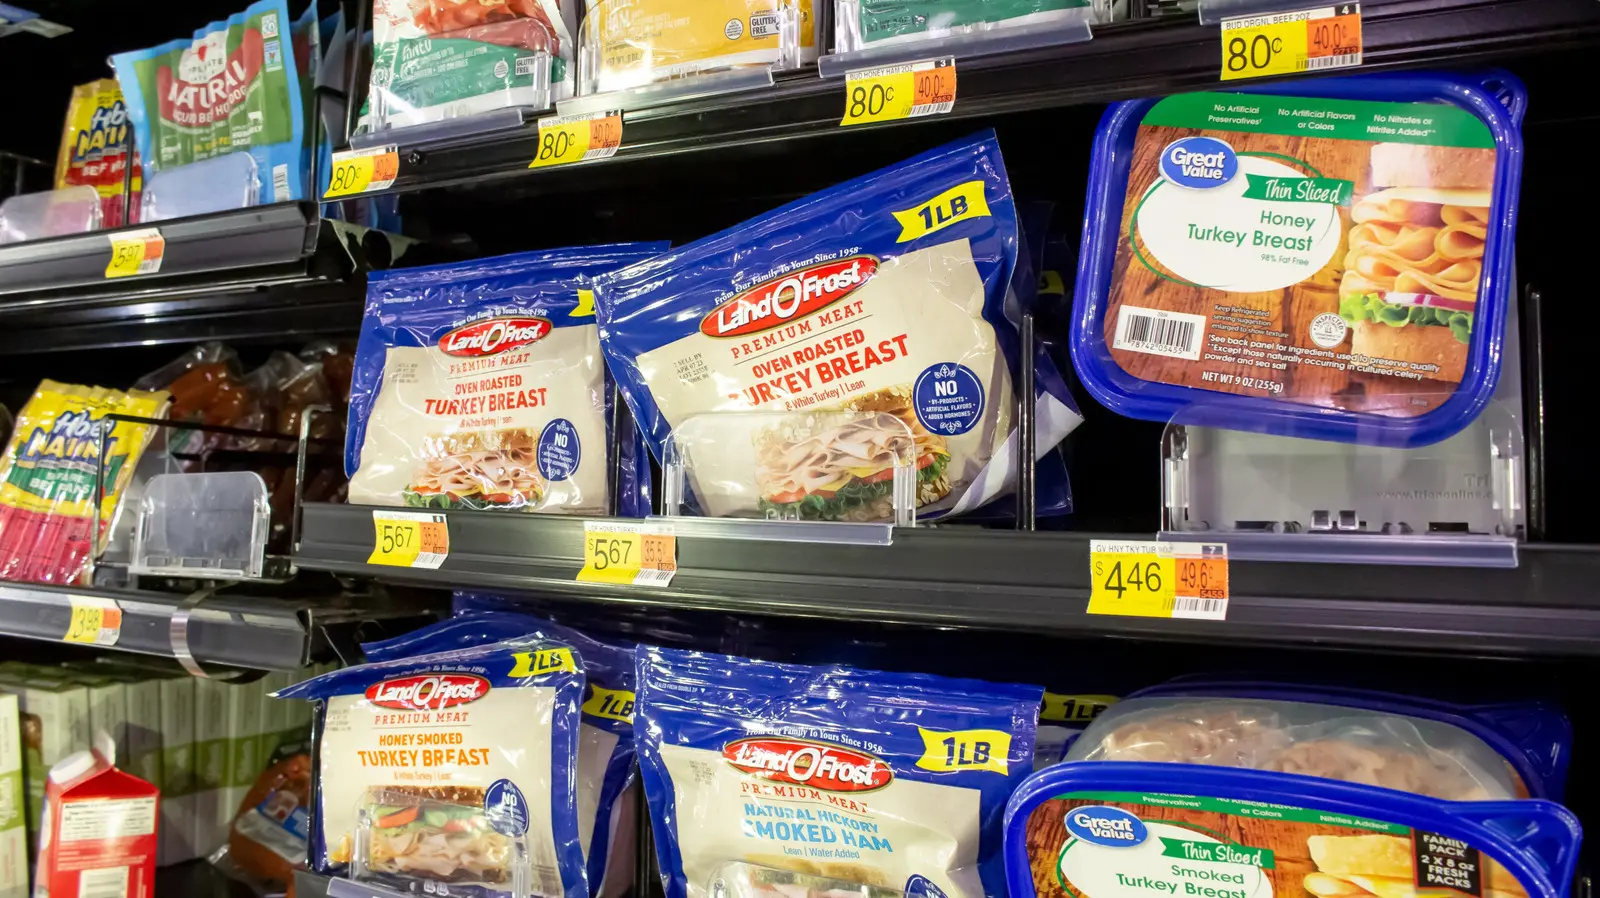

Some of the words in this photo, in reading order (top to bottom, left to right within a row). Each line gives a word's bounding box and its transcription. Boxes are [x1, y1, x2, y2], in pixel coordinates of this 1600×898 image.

[752, 16, 777, 27] GLUTEN
[1226, 21, 1242, 30] BUD
[1244, 18, 1273, 28] ORGNL
[1273, 14, 1293, 25] BEEF
[752, 26, 767, 35] FREE
[516, 57, 537, 66] GLUTE
[850, 72, 863, 80] BUD
[864, 69, 885, 78] HONEY
[886, 67, 900, 76] HAM
[1214, 104, 1225, 112] No
[1227, 105, 1260, 114] Artificial
[1278, 108, 1290, 116] No
[1292, 109, 1325, 119] Artificial
[1326, 111, 1356, 121] Flavors
[1297, 121, 1307, 129] or
[1308, 121, 1335, 131] Colors
[1373, 114, 1386, 123] No
[1388, 115, 1422, 125] Nitrates
[1423, 118, 1433, 126] or
[1367, 125, 1396, 135] Nitrites
[1170, 147, 1226, 169] Great
[1181, 165, 1223, 180] Value
[1265, 179, 1292, 200] Thin
[1295, 180, 1343, 203] Sliced
[1260, 210, 1316, 231] Honey
[1187, 223, 1247, 248] Turkey
[1252, 230, 1313, 251] Breast
[1260, 253, 1277, 263] 98%
[1278, 255, 1291, 264] Fat
[1292, 256, 1309, 266] Free
[714, 291, 734, 306] From
[735, 282, 751, 293] Our
[752, 270, 778, 285] Family
[779, 264, 790, 273] To
[791, 258, 814, 269] Yours
[814, 252, 837, 263] Since
[839, 246, 859, 257] 1958
[1214, 304, 1231, 313] Keep
[1231, 306, 1270, 317] Refrigerated
[1213, 314, 1236, 323] serving
[1237, 318, 1272, 327] suggestion
[1315, 315, 1344, 330] INSPECTED
[731, 320, 813, 359] PREMIUM
[818, 301, 864, 327] MEAT
[1211, 323, 1240, 332] enlarged
[1248, 327, 1265, 335] show
[1266, 330, 1289, 338] texture
[752, 354, 792, 379] OVEN
[793, 328, 865, 365] ROASTED
[1130, 341, 1155, 350] 78742
[1158, 345, 1183, 354] 05455
[1227, 337, 1249, 346] back
[1250, 341, 1275, 350] panel
[1276, 343, 1287, 351] for
[1288, 345, 1334, 359] ingredients
[1336, 352, 1358, 361] used
[1359, 354, 1368, 363] to
[1370, 356, 1408, 368] preserve
[1411, 361, 1440, 373] quality
[501, 353, 531, 366] MEAT
[1204, 353, 1236, 363] powder
[1237, 357, 1254, 366] and
[1255, 360, 1271, 368] sea
[1272, 362, 1287, 370] salt
[1243, 348, 1265, 358] those
[1267, 352, 1303, 364] naturally
[1304, 358, 1346, 371] occurring
[1347, 362, 1355, 370] in
[1357, 364, 1393, 376] cultured
[1394, 368, 1423, 380] celery
[728, 367, 813, 407] URKEY
[815, 333, 909, 384] BREAST
[455, 381, 478, 395] OVEN
[480, 374, 523, 392] ROASTED
[934, 380, 958, 397] NO
[1202, 371, 1219, 382] NET
[1220, 373, 1234, 384] WT
[1234, 376, 1241, 385] 9
[1241, 378, 1255, 388] OZ
[1255, 379, 1284, 393] (255g)
[425, 395, 486, 415] TURKEY
[489, 387, 547, 412] BREAST
[792, 394, 815, 410] White
[815, 387, 840, 404] Turkey
[846, 378, 866, 393] Lean
[931, 396, 965, 405] BY-PRODUCTS
[925, 404, 950, 413] ARTIFICIAL
[951, 402, 973, 411] FLAVORS
[554, 432, 568, 448] NO
[1096, 544, 1107, 553] GV
[1108, 545, 1126, 553] HNY
[1126, 545, 1140, 553] TKY
[1142, 546, 1156, 554] TUB
[375, 713, 431, 725] PREMIUM
[436, 711, 469, 723] MEAT
[379, 733, 415, 746] HONEY
[417, 732, 463, 745] SMOKED
[783, 726, 808, 739] Family
[809, 729, 818, 738] To
[820, 730, 839, 742] Yours
[841, 734, 861, 748] Since
[863, 741, 883, 753] 1958
[358, 749, 418, 767] TURKEY
[423, 748, 490, 767] BREAST
[827, 794, 868, 813] MEAT
[744, 803, 815, 822] NATURAL
[817, 809, 878, 834] HICKORY
[1252, 809, 1282, 818] Colors
[1320, 815, 1352, 825] Nitrites
[1073, 813, 1133, 833] Great
[841, 829, 893, 853] HAM
[1089, 826, 1135, 841] Value
[1422, 834, 1468, 850] FAMILY
[784, 845, 803, 856] Lean
[809, 847, 833, 859] Water
[834, 849, 860, 859] Added
[1182, 842, 1212, 861] Thin
[1215, 845, 1263, 867] Sliced
[1428, 844, 1466, 858] PACK
[1421, 854, 1430, 864] 2
[1446, 858, 1456, 867] 8
[1458, 863, 1475, 872] OZ
[1171, 864, 1245, 885] Smoked
[1428, 865, 1468, 879] FRESH
[1116, 872, 1178, 896] Turkey
[1185, 881, 1247, 898] Breast
[1427, 874, 1472, 889] PACKS
